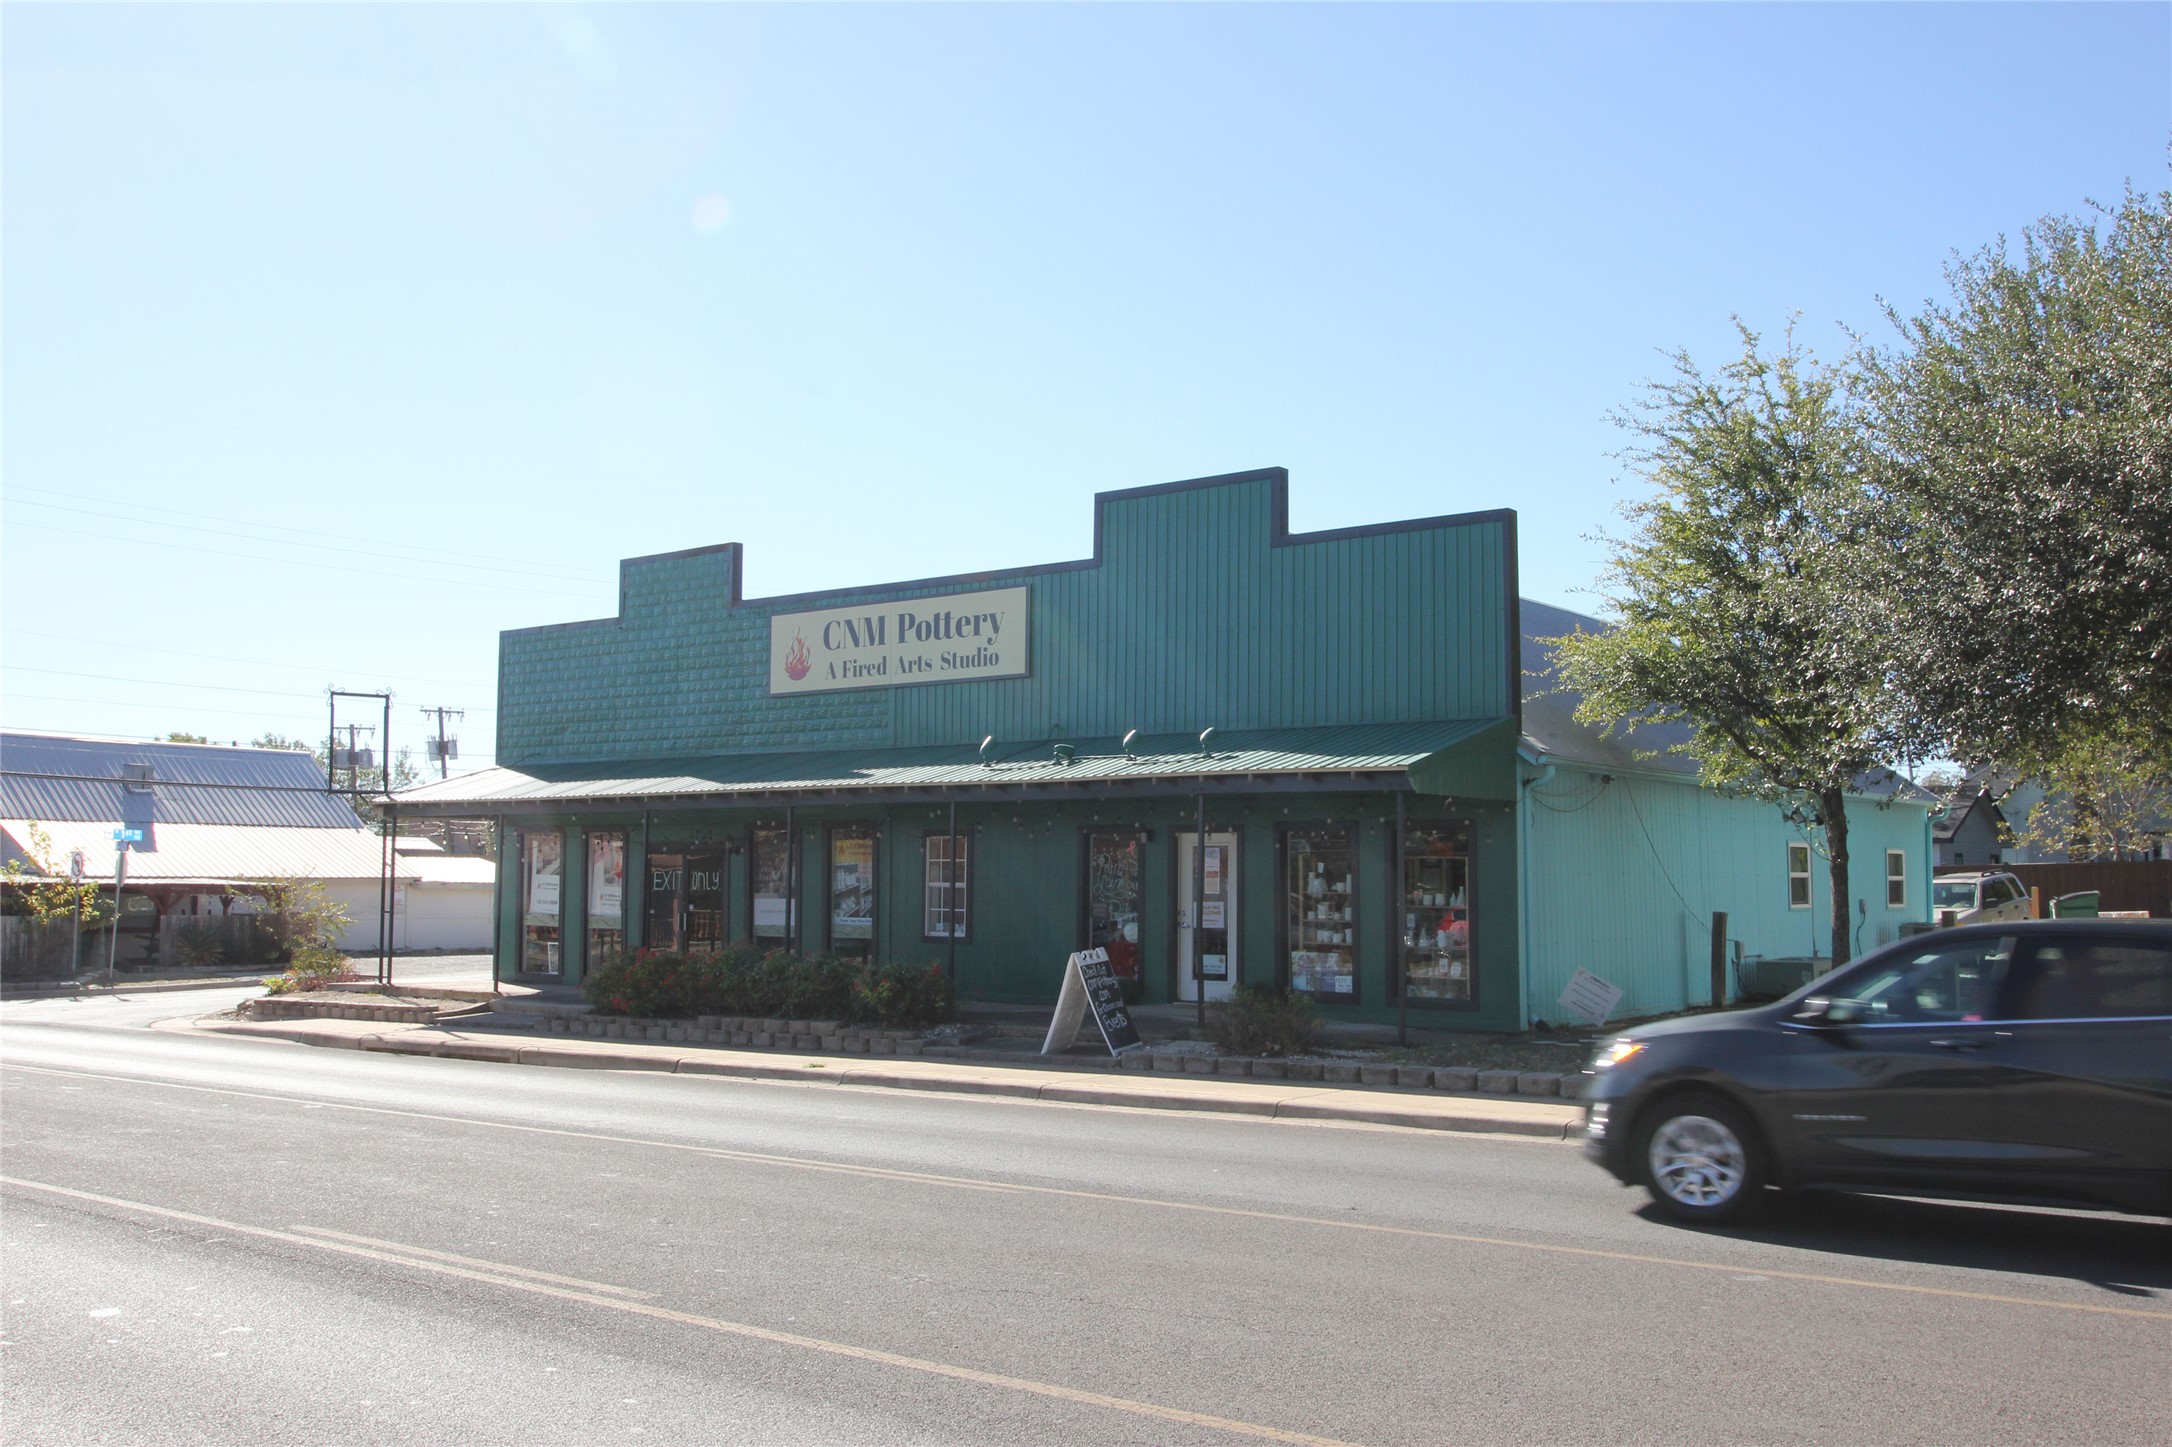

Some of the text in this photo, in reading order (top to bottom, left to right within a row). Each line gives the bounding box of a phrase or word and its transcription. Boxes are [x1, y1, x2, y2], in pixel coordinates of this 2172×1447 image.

[823, 611, 1005, 651] CNM Pottery
[825, 647, 1000, 680] A Fired Arts Studio
[653, 870, 683, 890] EXIT
